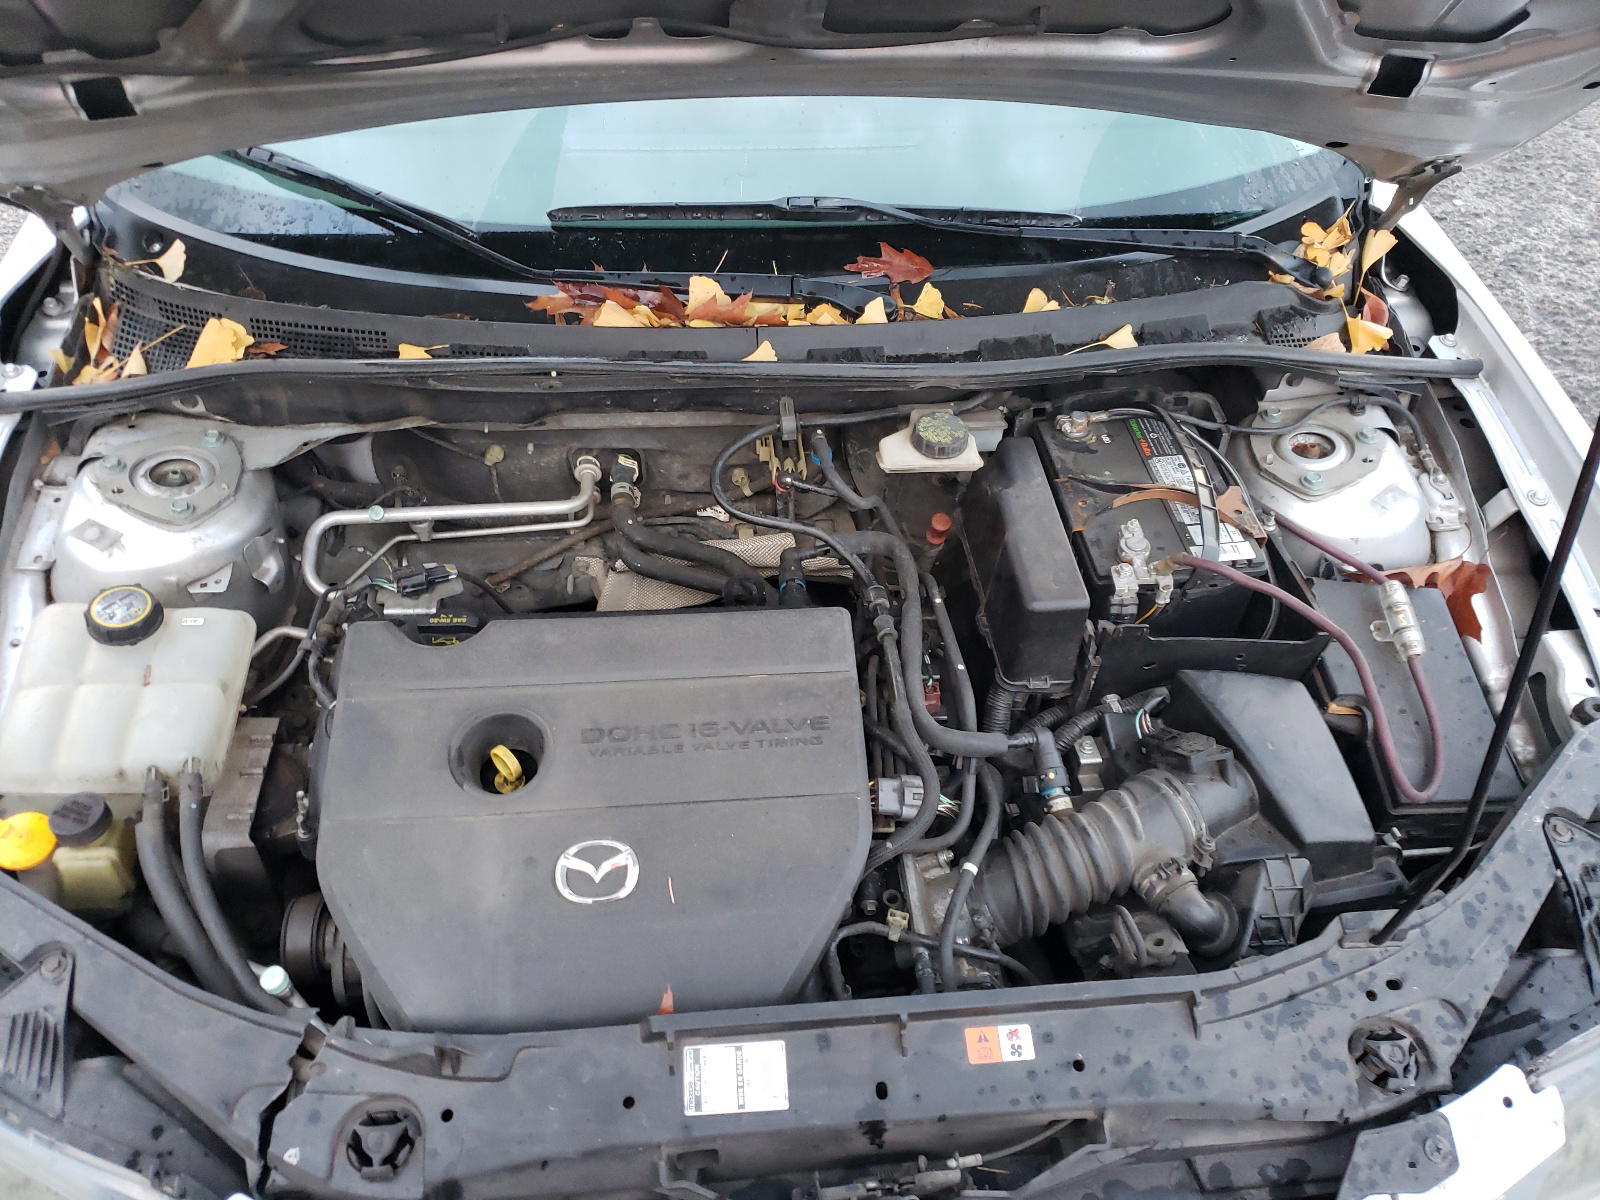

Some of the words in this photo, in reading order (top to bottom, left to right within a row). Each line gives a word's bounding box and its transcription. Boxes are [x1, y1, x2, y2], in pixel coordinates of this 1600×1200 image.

[580, 723, 681, 744] DOHC
[688, 715, 831, 738] 16-VALVE
[588, 743, 685, 758] VARIABLE
[691, 739, 750, 753] VALVE
[752, 735, 824, 750] TIMING
